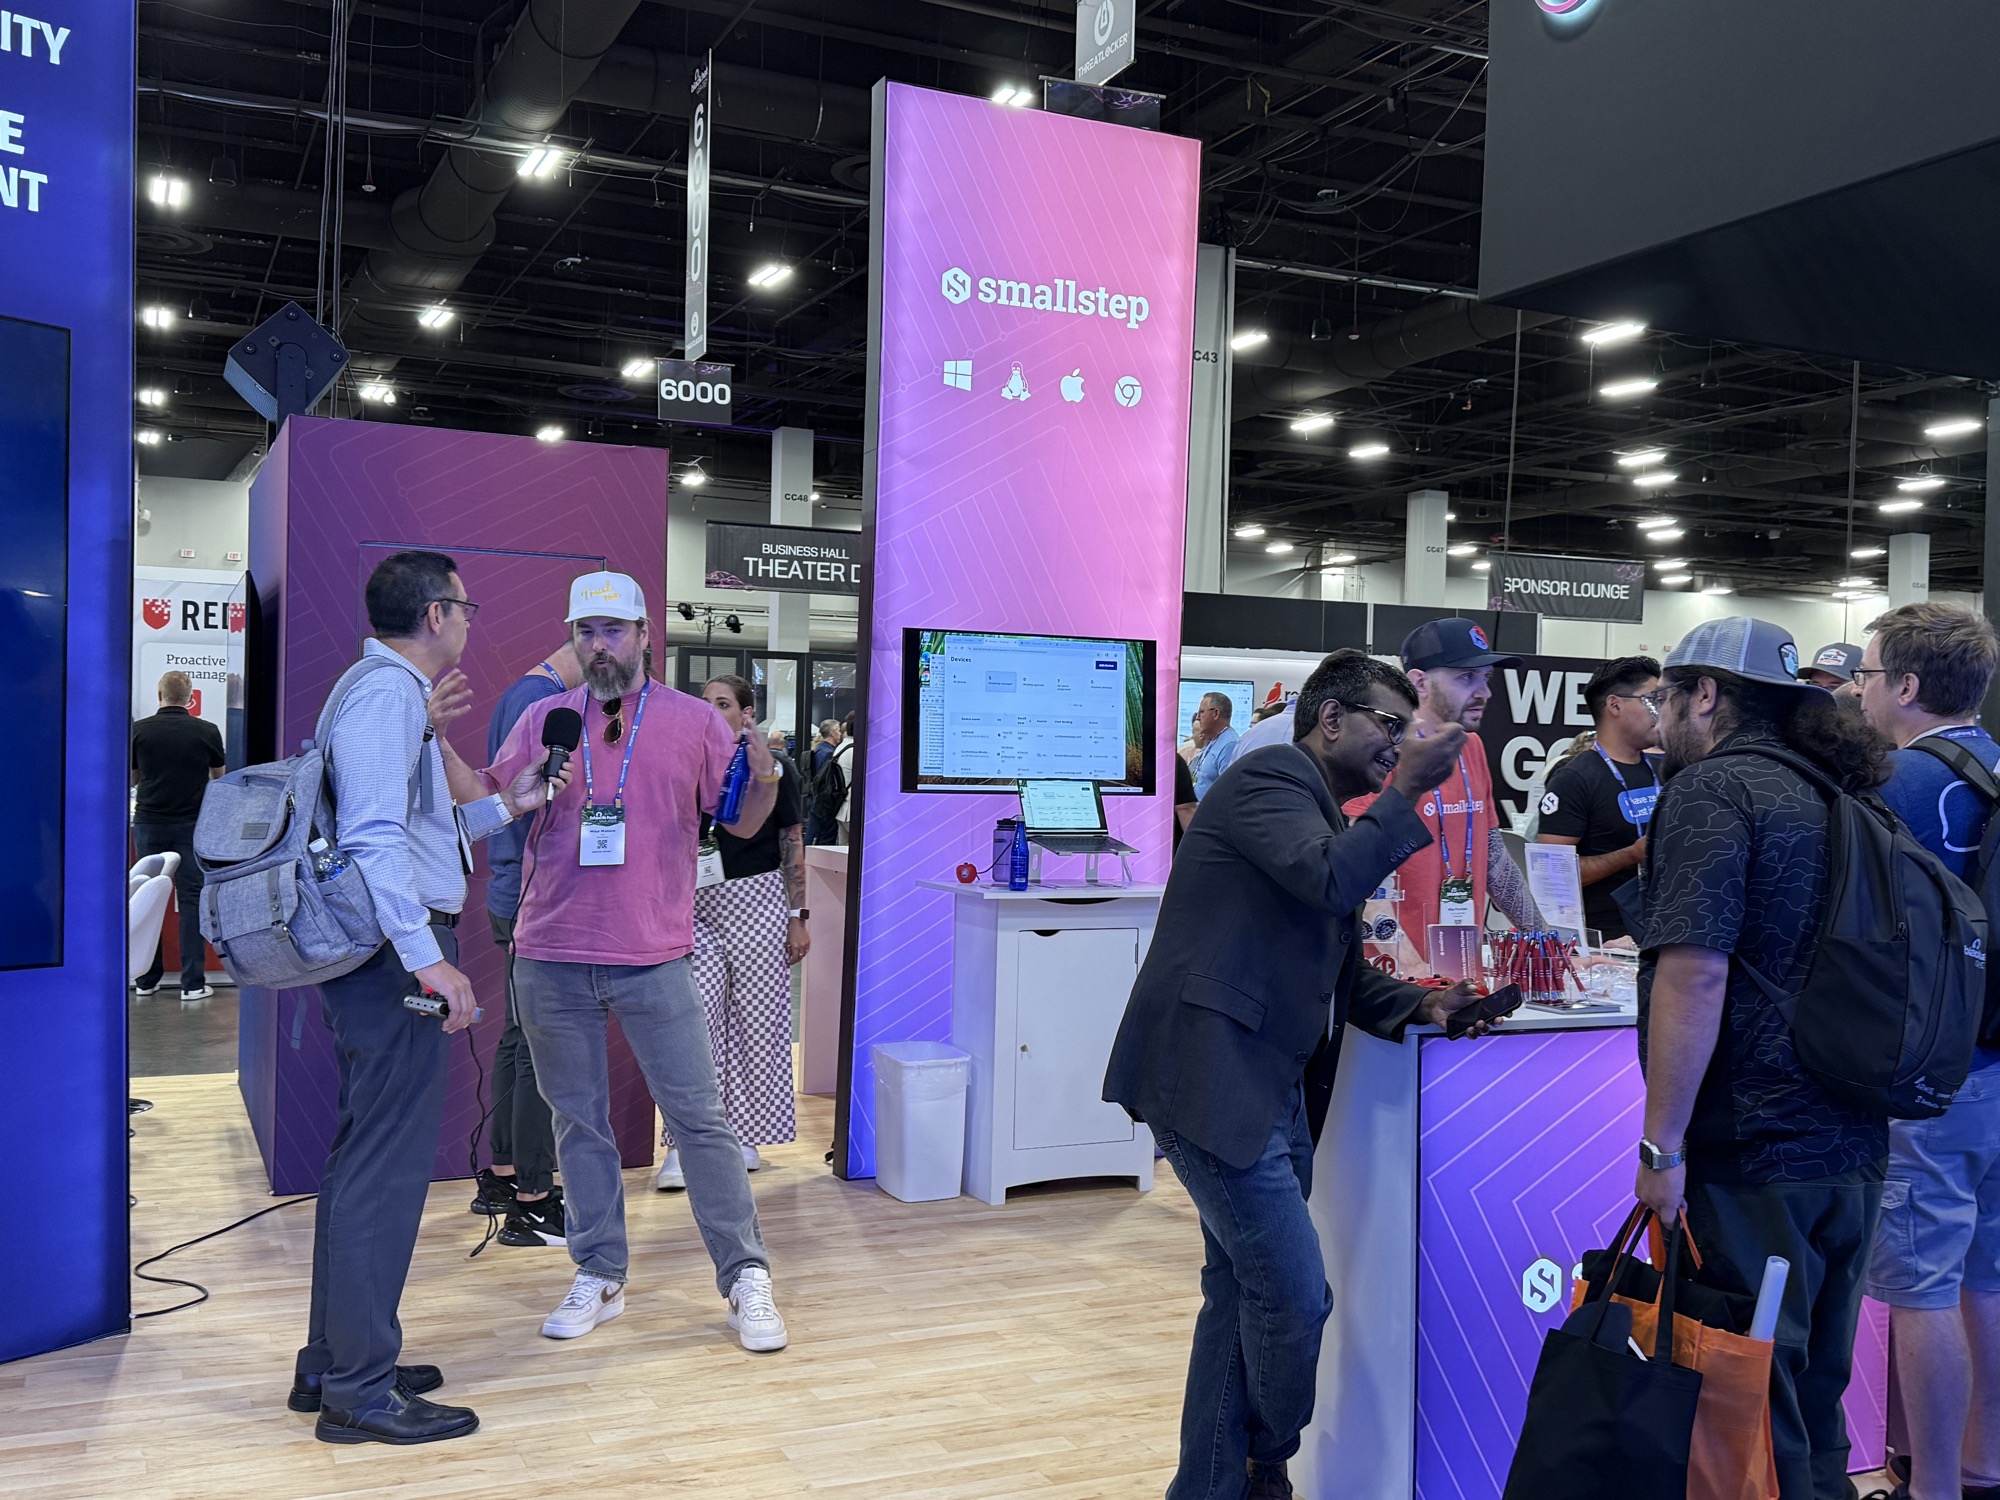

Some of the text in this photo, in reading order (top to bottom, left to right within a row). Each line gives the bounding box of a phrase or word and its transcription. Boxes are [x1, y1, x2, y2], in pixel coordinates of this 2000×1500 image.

[1, 10, 71, 65] ITY
[1077, 32, 1128, 78] THREATLOCKER
[0, 110, 25, 155] E
[691, 102, 704, 282] 6000
[977, 276, 1150, 329] smallstep
[660, 378, 731, 405] 6000
[784, 493, 809, 502] CC48
[762, 543, 849, 559] BUSINESS HALL
[743, 556, 845, 583] THEATER
[1504, 577, 1630, 599] SPONSOR LOUNGE
[166, 654, 226, 666] Proactive
[1503, 668, 1596, 726] WE
